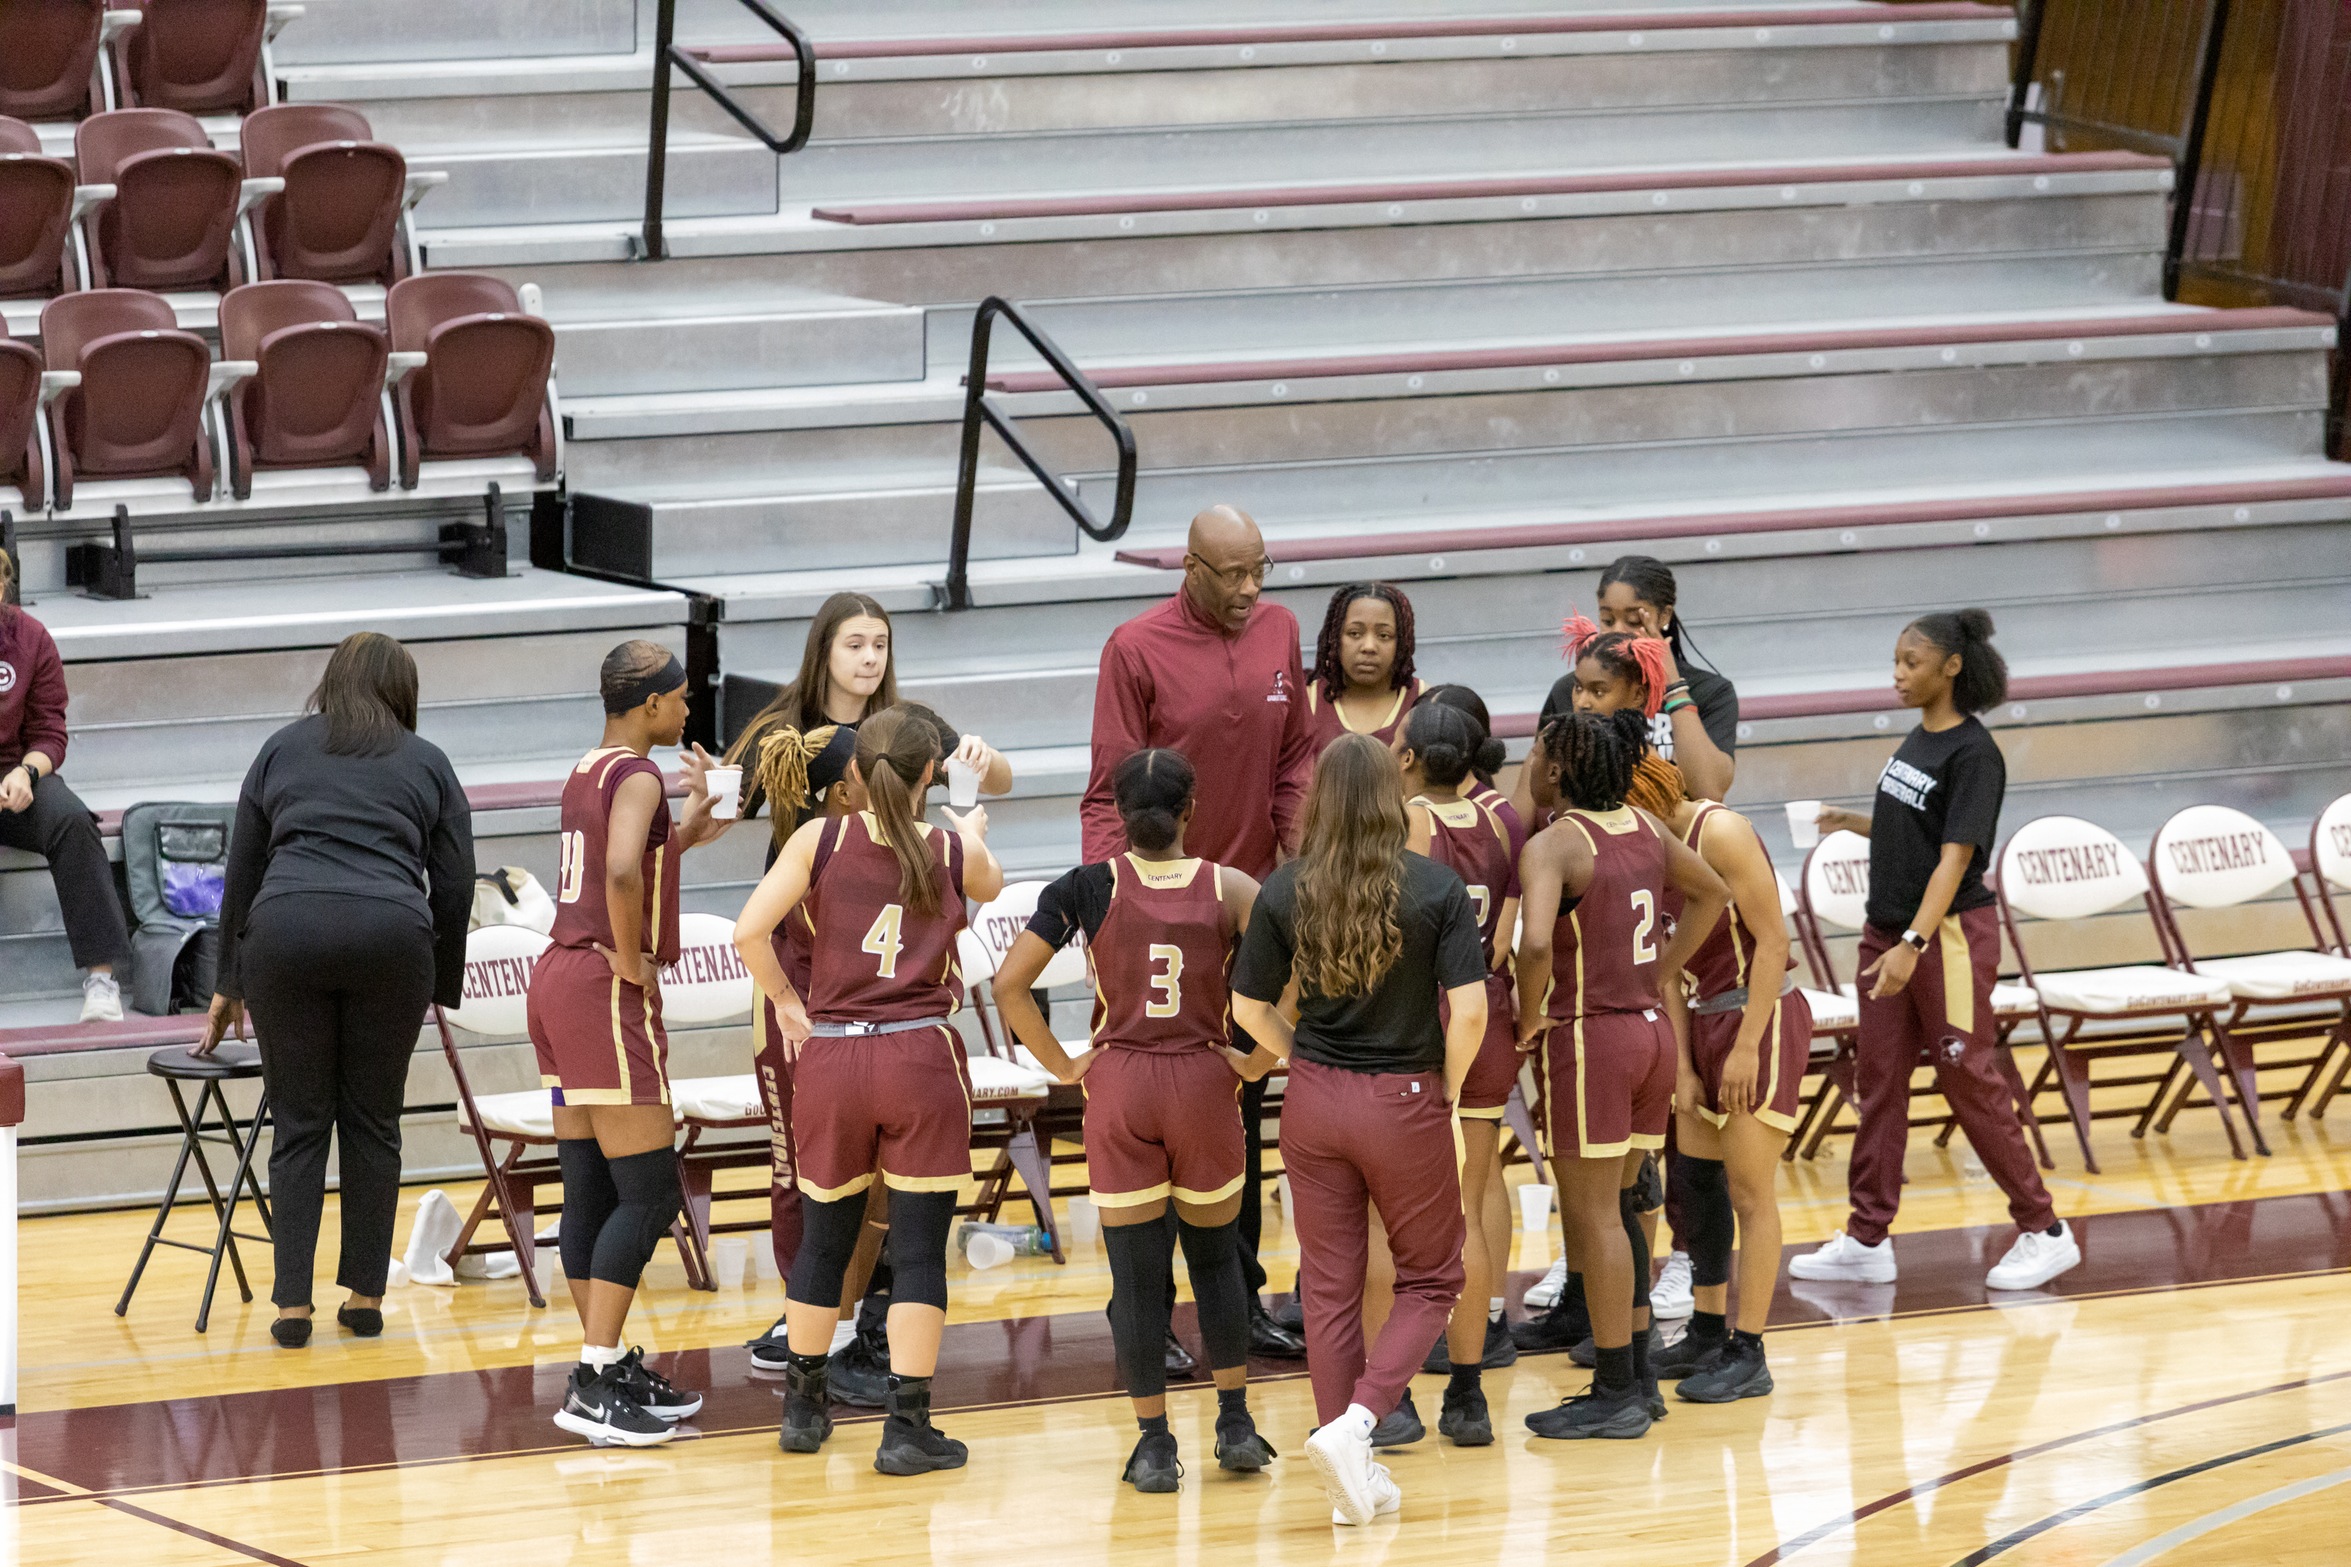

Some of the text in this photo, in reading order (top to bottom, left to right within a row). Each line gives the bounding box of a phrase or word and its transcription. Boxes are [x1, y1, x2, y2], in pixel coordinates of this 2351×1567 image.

[1147, 872, 1183, 882] CENTENARY
[2017, 843, 2120, 884] CENTENARY
[2166, 832, 2266, 873] CENTENARY
[861, 903, 905, 979] 4
[1631, 888, 1657, 966] 2
[1145, 943, 1185, 1018] 3
